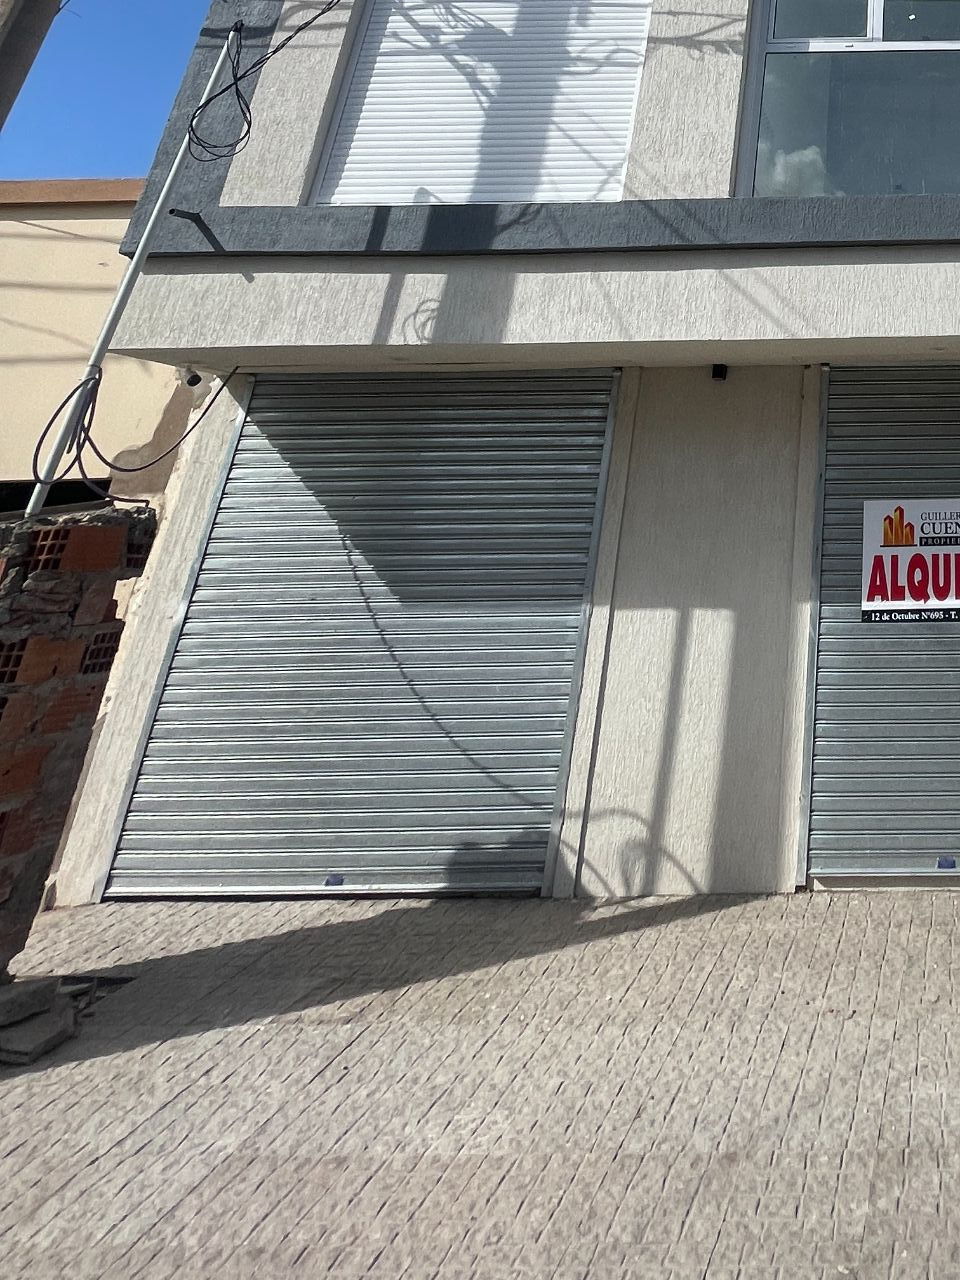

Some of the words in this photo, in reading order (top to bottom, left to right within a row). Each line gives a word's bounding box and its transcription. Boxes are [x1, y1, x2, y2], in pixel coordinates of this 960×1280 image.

[871, 612, 881, 621] 12
[881, 612, 891, 621] de
[891, 611, 920, 621] Octubre
[950, 610, 959, 619] T.
